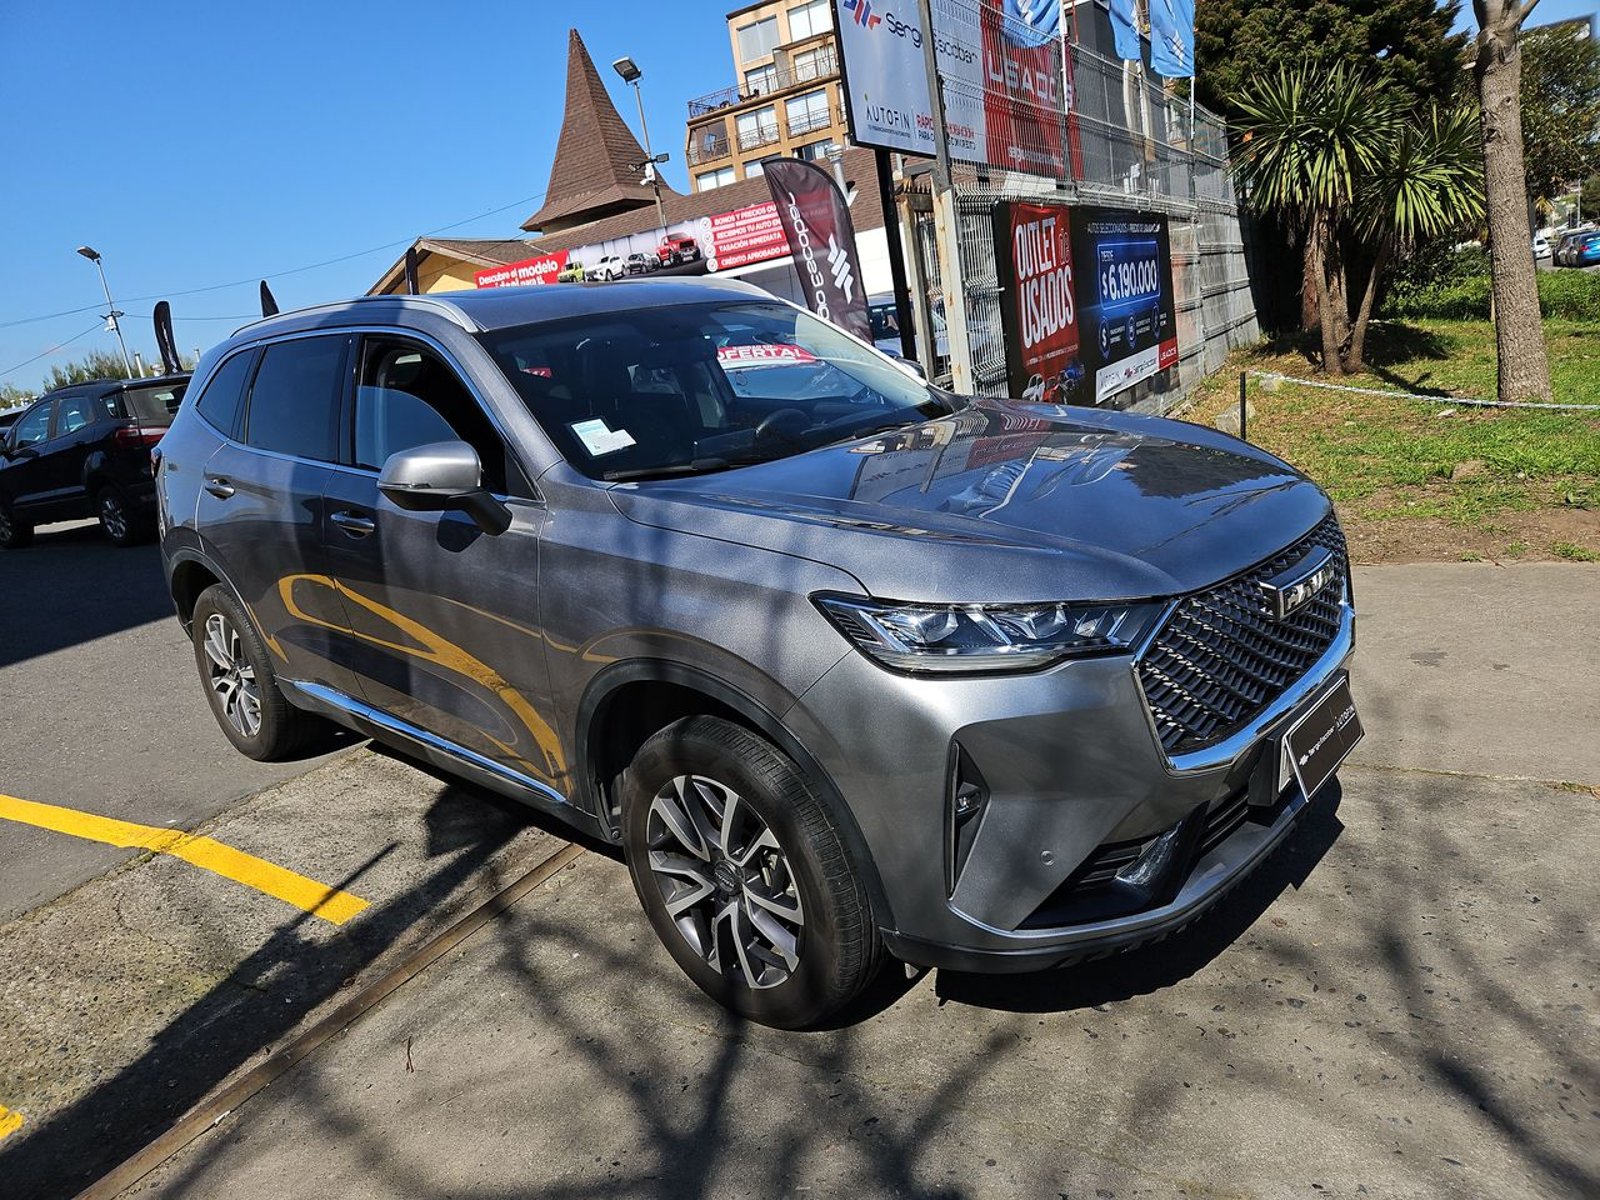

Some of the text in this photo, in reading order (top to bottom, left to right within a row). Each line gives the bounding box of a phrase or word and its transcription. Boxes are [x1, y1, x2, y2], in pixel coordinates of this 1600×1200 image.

[885, 12, 923, 48] Serg
[866, 105, 911, 131] AUTOFIN
[756, 220, 772, 231] AUTO
[1016, 216, 1056, 281] OUTLET
[479, 260, 558, 285] Descubre el modelo
[1021, 265, 1073, 349] USADOS
